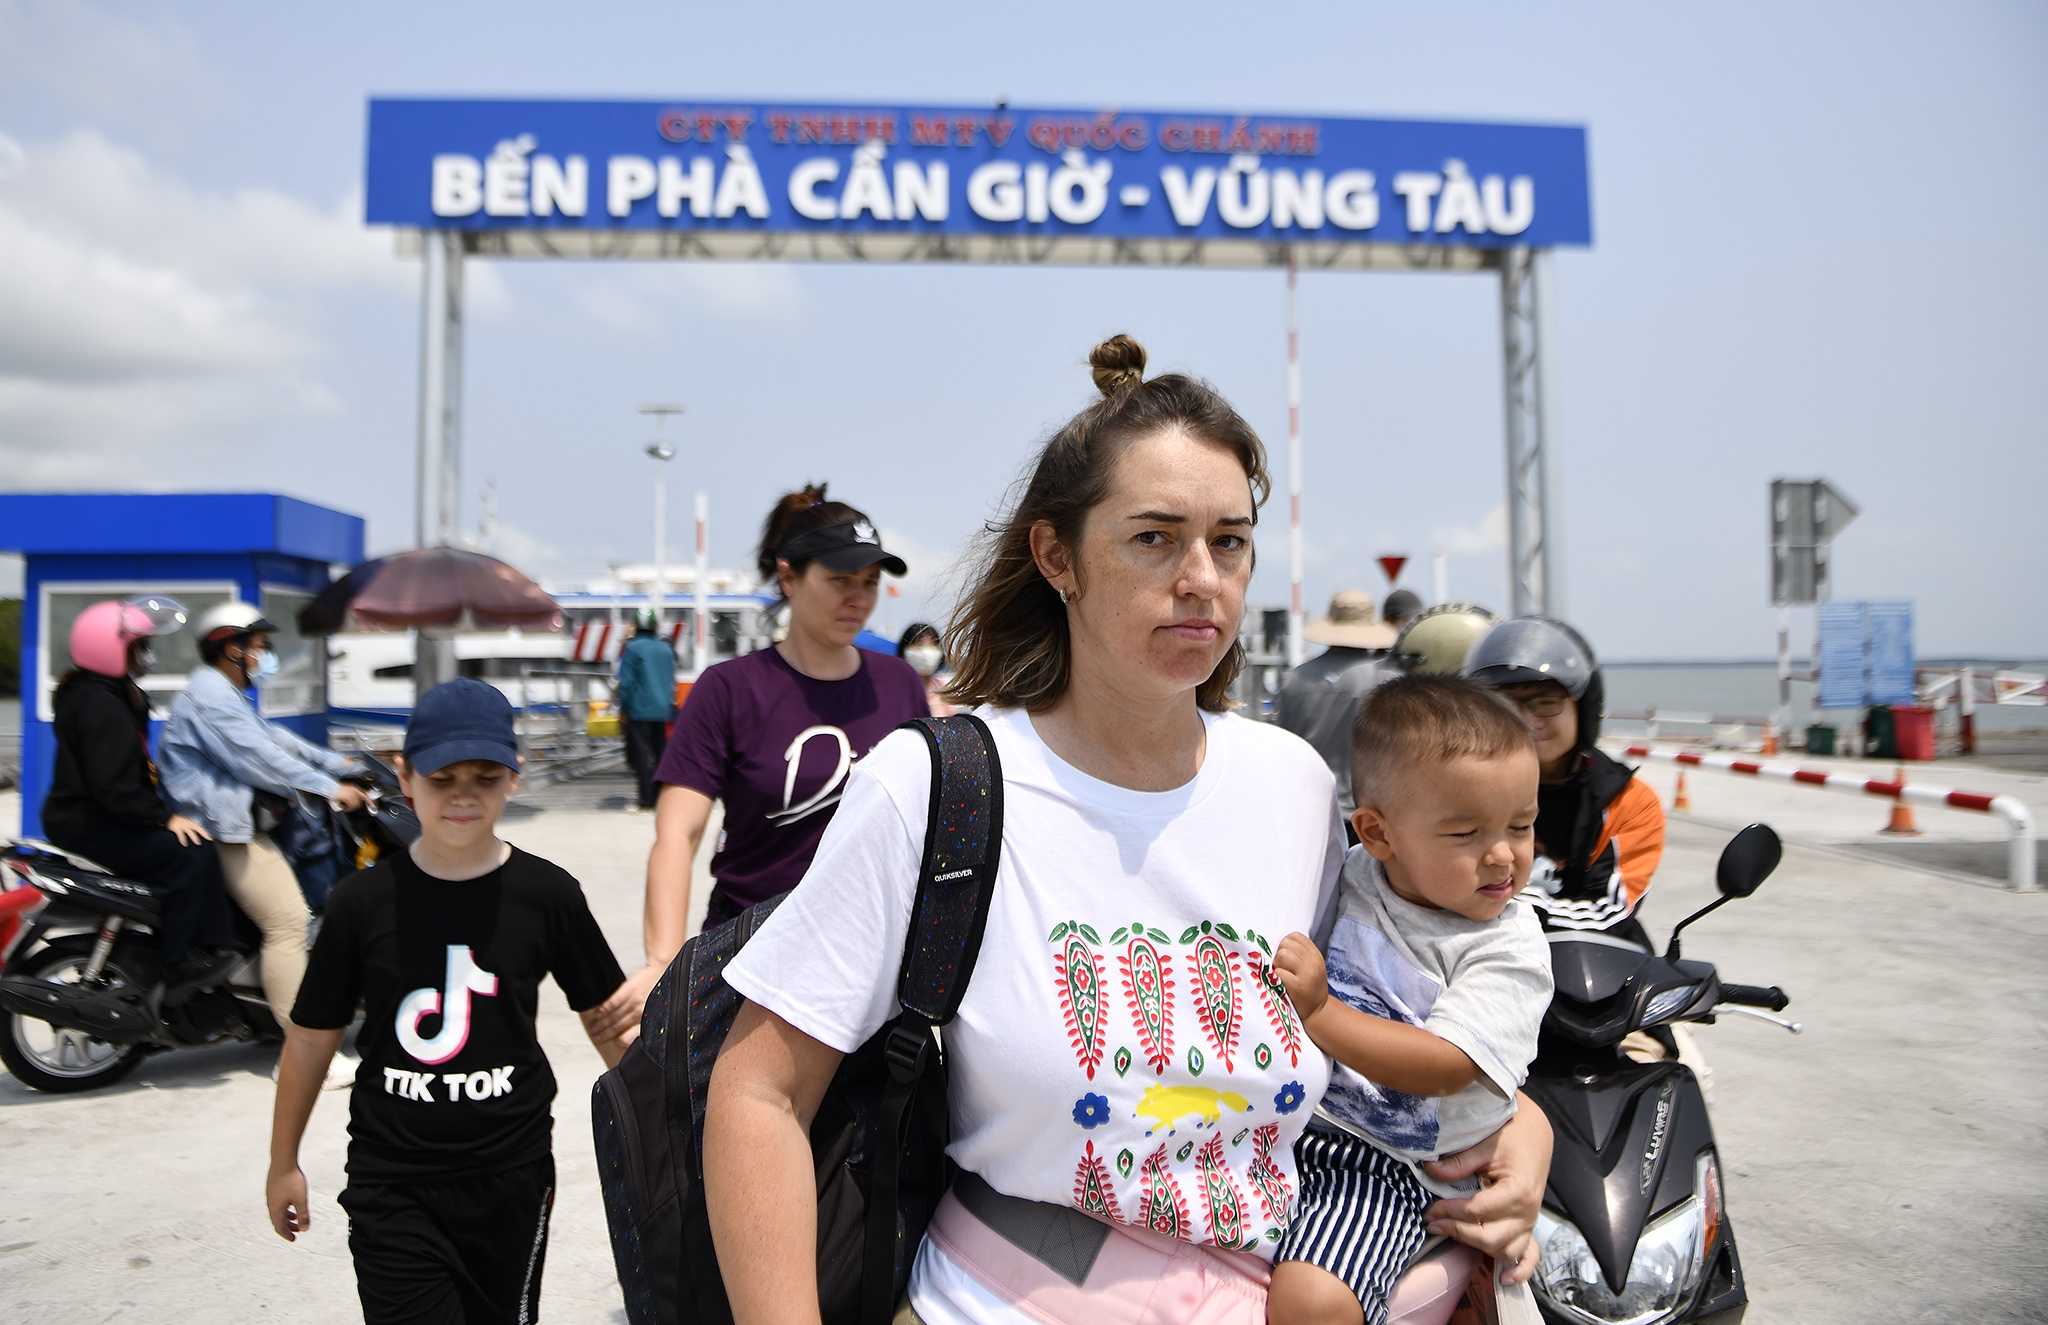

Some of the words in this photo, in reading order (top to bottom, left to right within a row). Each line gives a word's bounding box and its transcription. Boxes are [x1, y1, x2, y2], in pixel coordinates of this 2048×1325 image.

[658, 109, 755, 143] CTY
[765, 110, 896, 145] TNHH
[909, 111, 1015, 148] MTV
[1027, 105, 1149, 153] QUỐC
[1160, 112, 1319, 156] CHÁNH
[432, 133, 588, 218] BẾN
[607, 143, 771, 218] PHÀ
[788, 140, 949, 221] CẦN
[967, 148, 1112, 224] GIỜ
[1119, 185, 1149, 206] -
[1160, 154, 1379, 230] VŨNG
[1393, 159, 1534, 235] TÀU
[934, 869, 973, 882] QUIKSILVER
[383, 1066, 436, 1102] TIK
[442, 1065, 515, 1102] TOK
